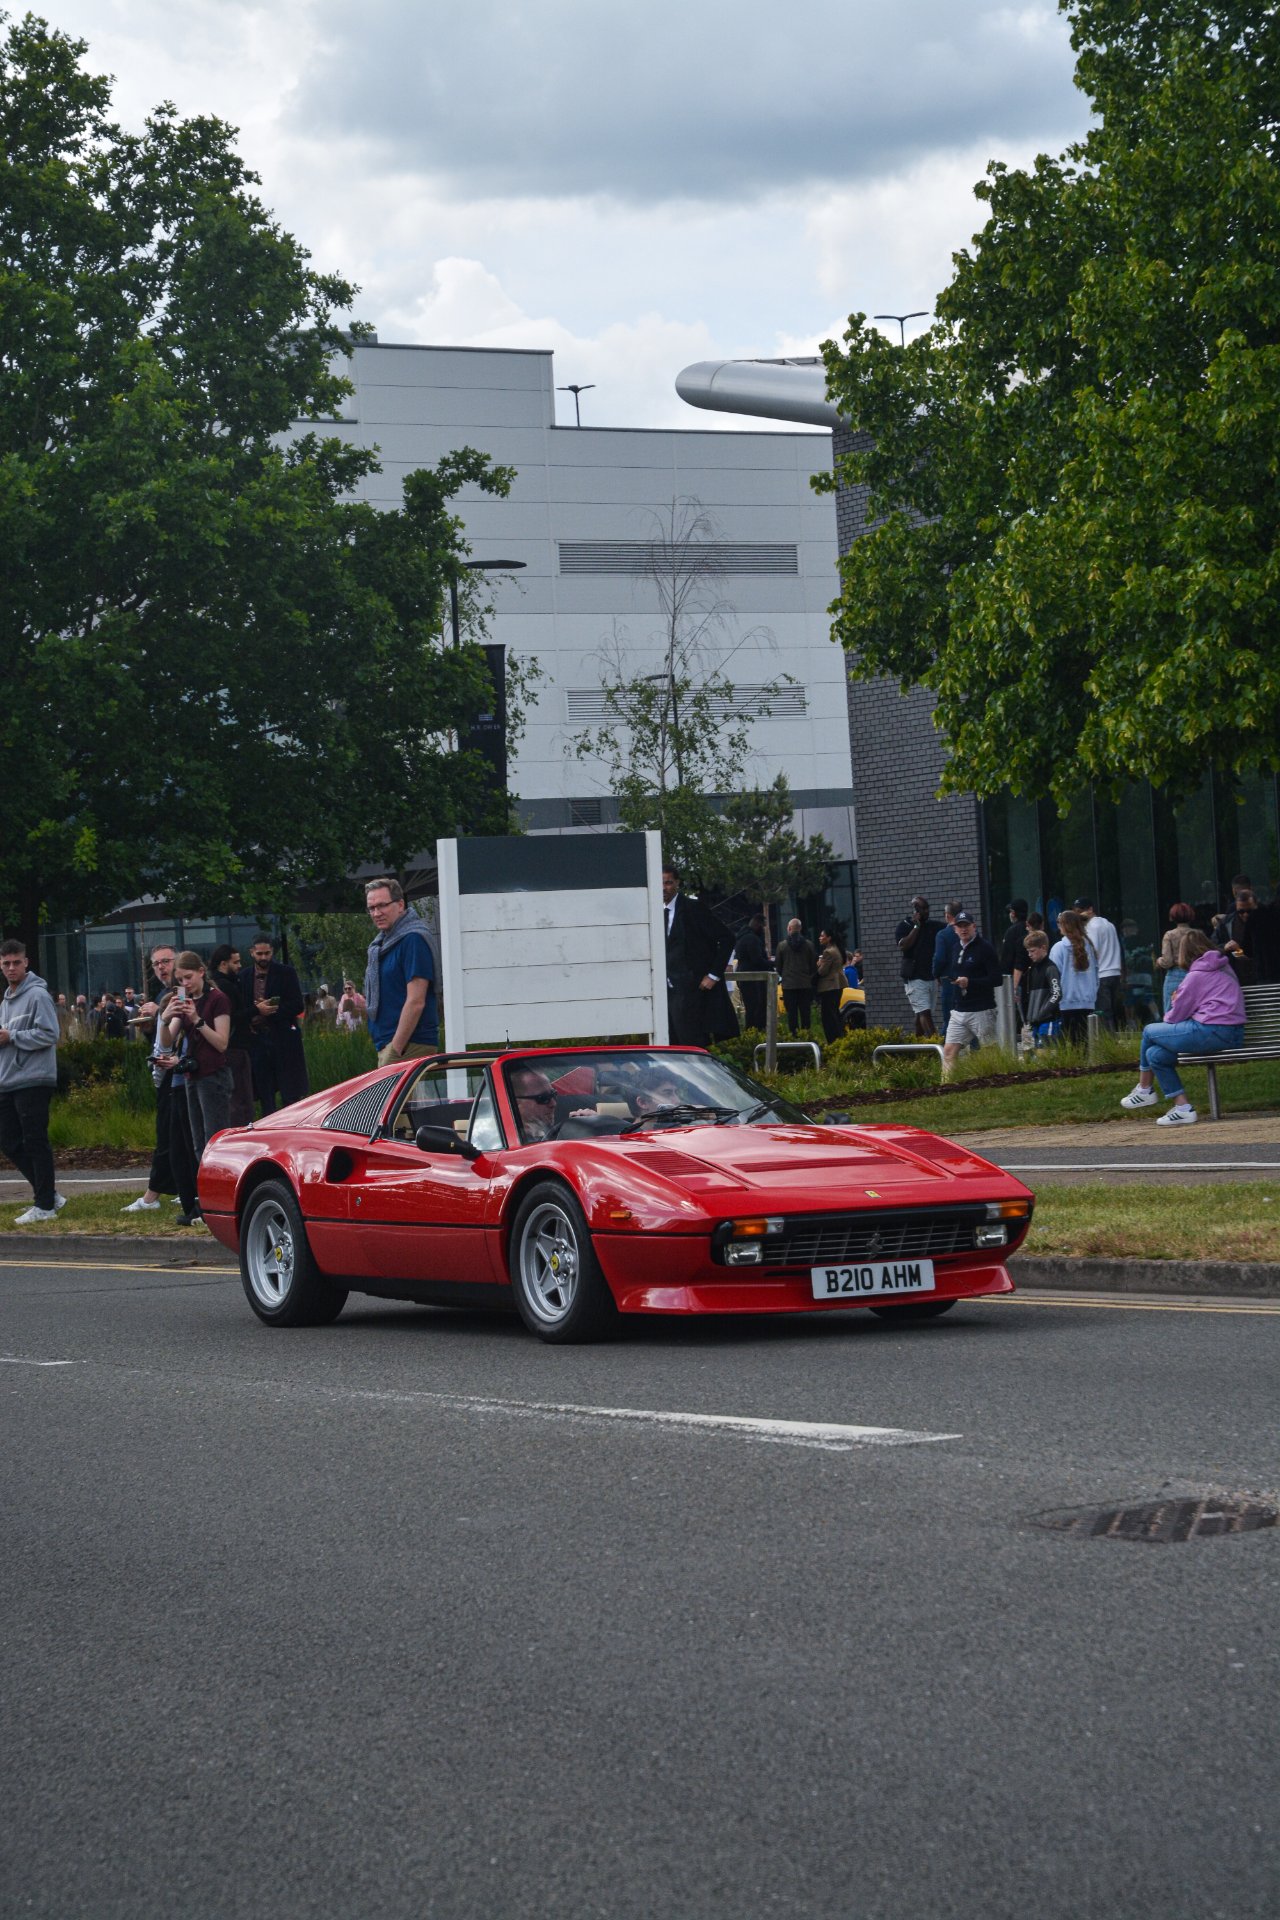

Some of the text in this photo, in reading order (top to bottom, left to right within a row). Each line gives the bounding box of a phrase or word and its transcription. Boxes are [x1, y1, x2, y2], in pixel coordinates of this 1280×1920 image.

[1049, 978, 1061, 1004] adidas
[825, 1264, 922, 1293] B210 AHM
